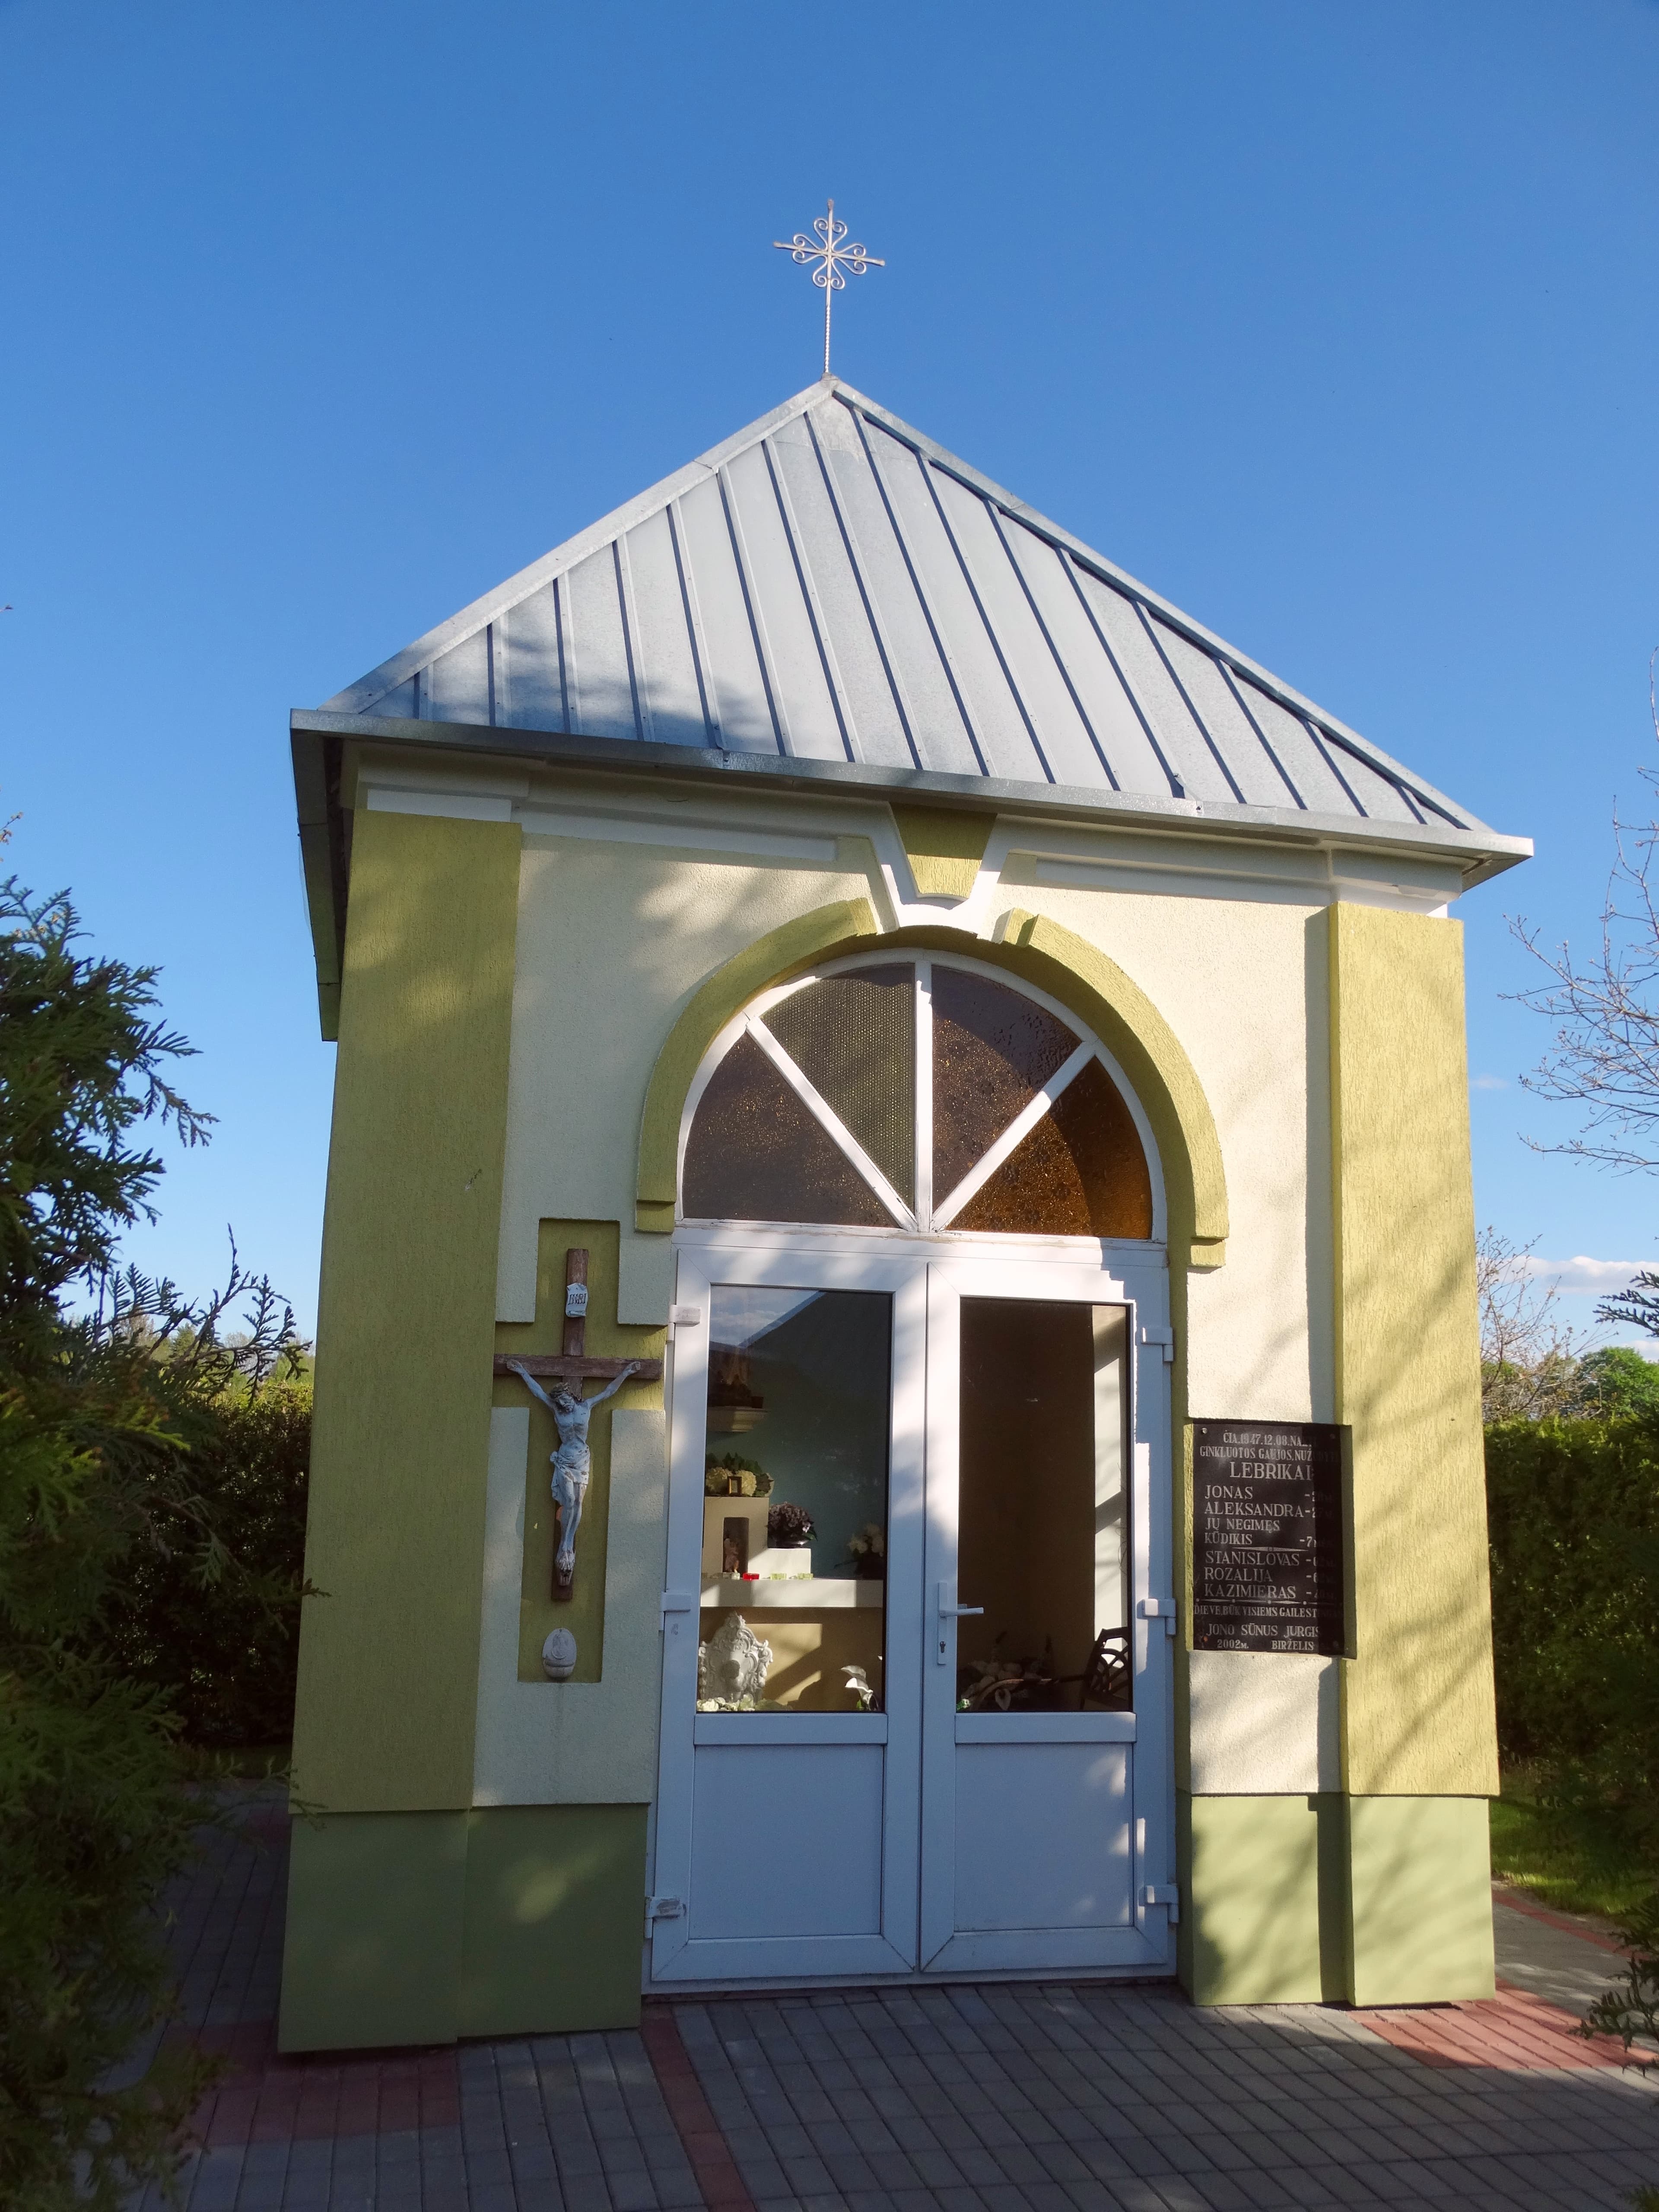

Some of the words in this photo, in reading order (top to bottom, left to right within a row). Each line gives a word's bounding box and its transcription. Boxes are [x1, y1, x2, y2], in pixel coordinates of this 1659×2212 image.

[1200, 1446, 1256, 1459] GINKLUOTOS
[1205, 1485, 1253, 1499] JONAS
[1204, 1502, 1304, 1517] ALEKSANDRA
[1205, 1518, 1220, 1531] JŲ
[1227, 1519, 1281, 1533] NEGIMĘS
[1205, 1531, 1252, 1545] KŪDIKIS
[1205, 1551, 1300, 1566] STANISLOVAS
[1204, 1567, 1273, 1582] ROZALIJA
[1205, 1583, 1296, 1599] KAZIMIERAS
[1243, 1606, 1278, 1616] VISIEMS
[1206, 1624, 1235, 1636] JONO
[1241, 1623, 1278, 1636] SŪNUS
[1271, 1638, 1314, 1650] BIRŽELIS
